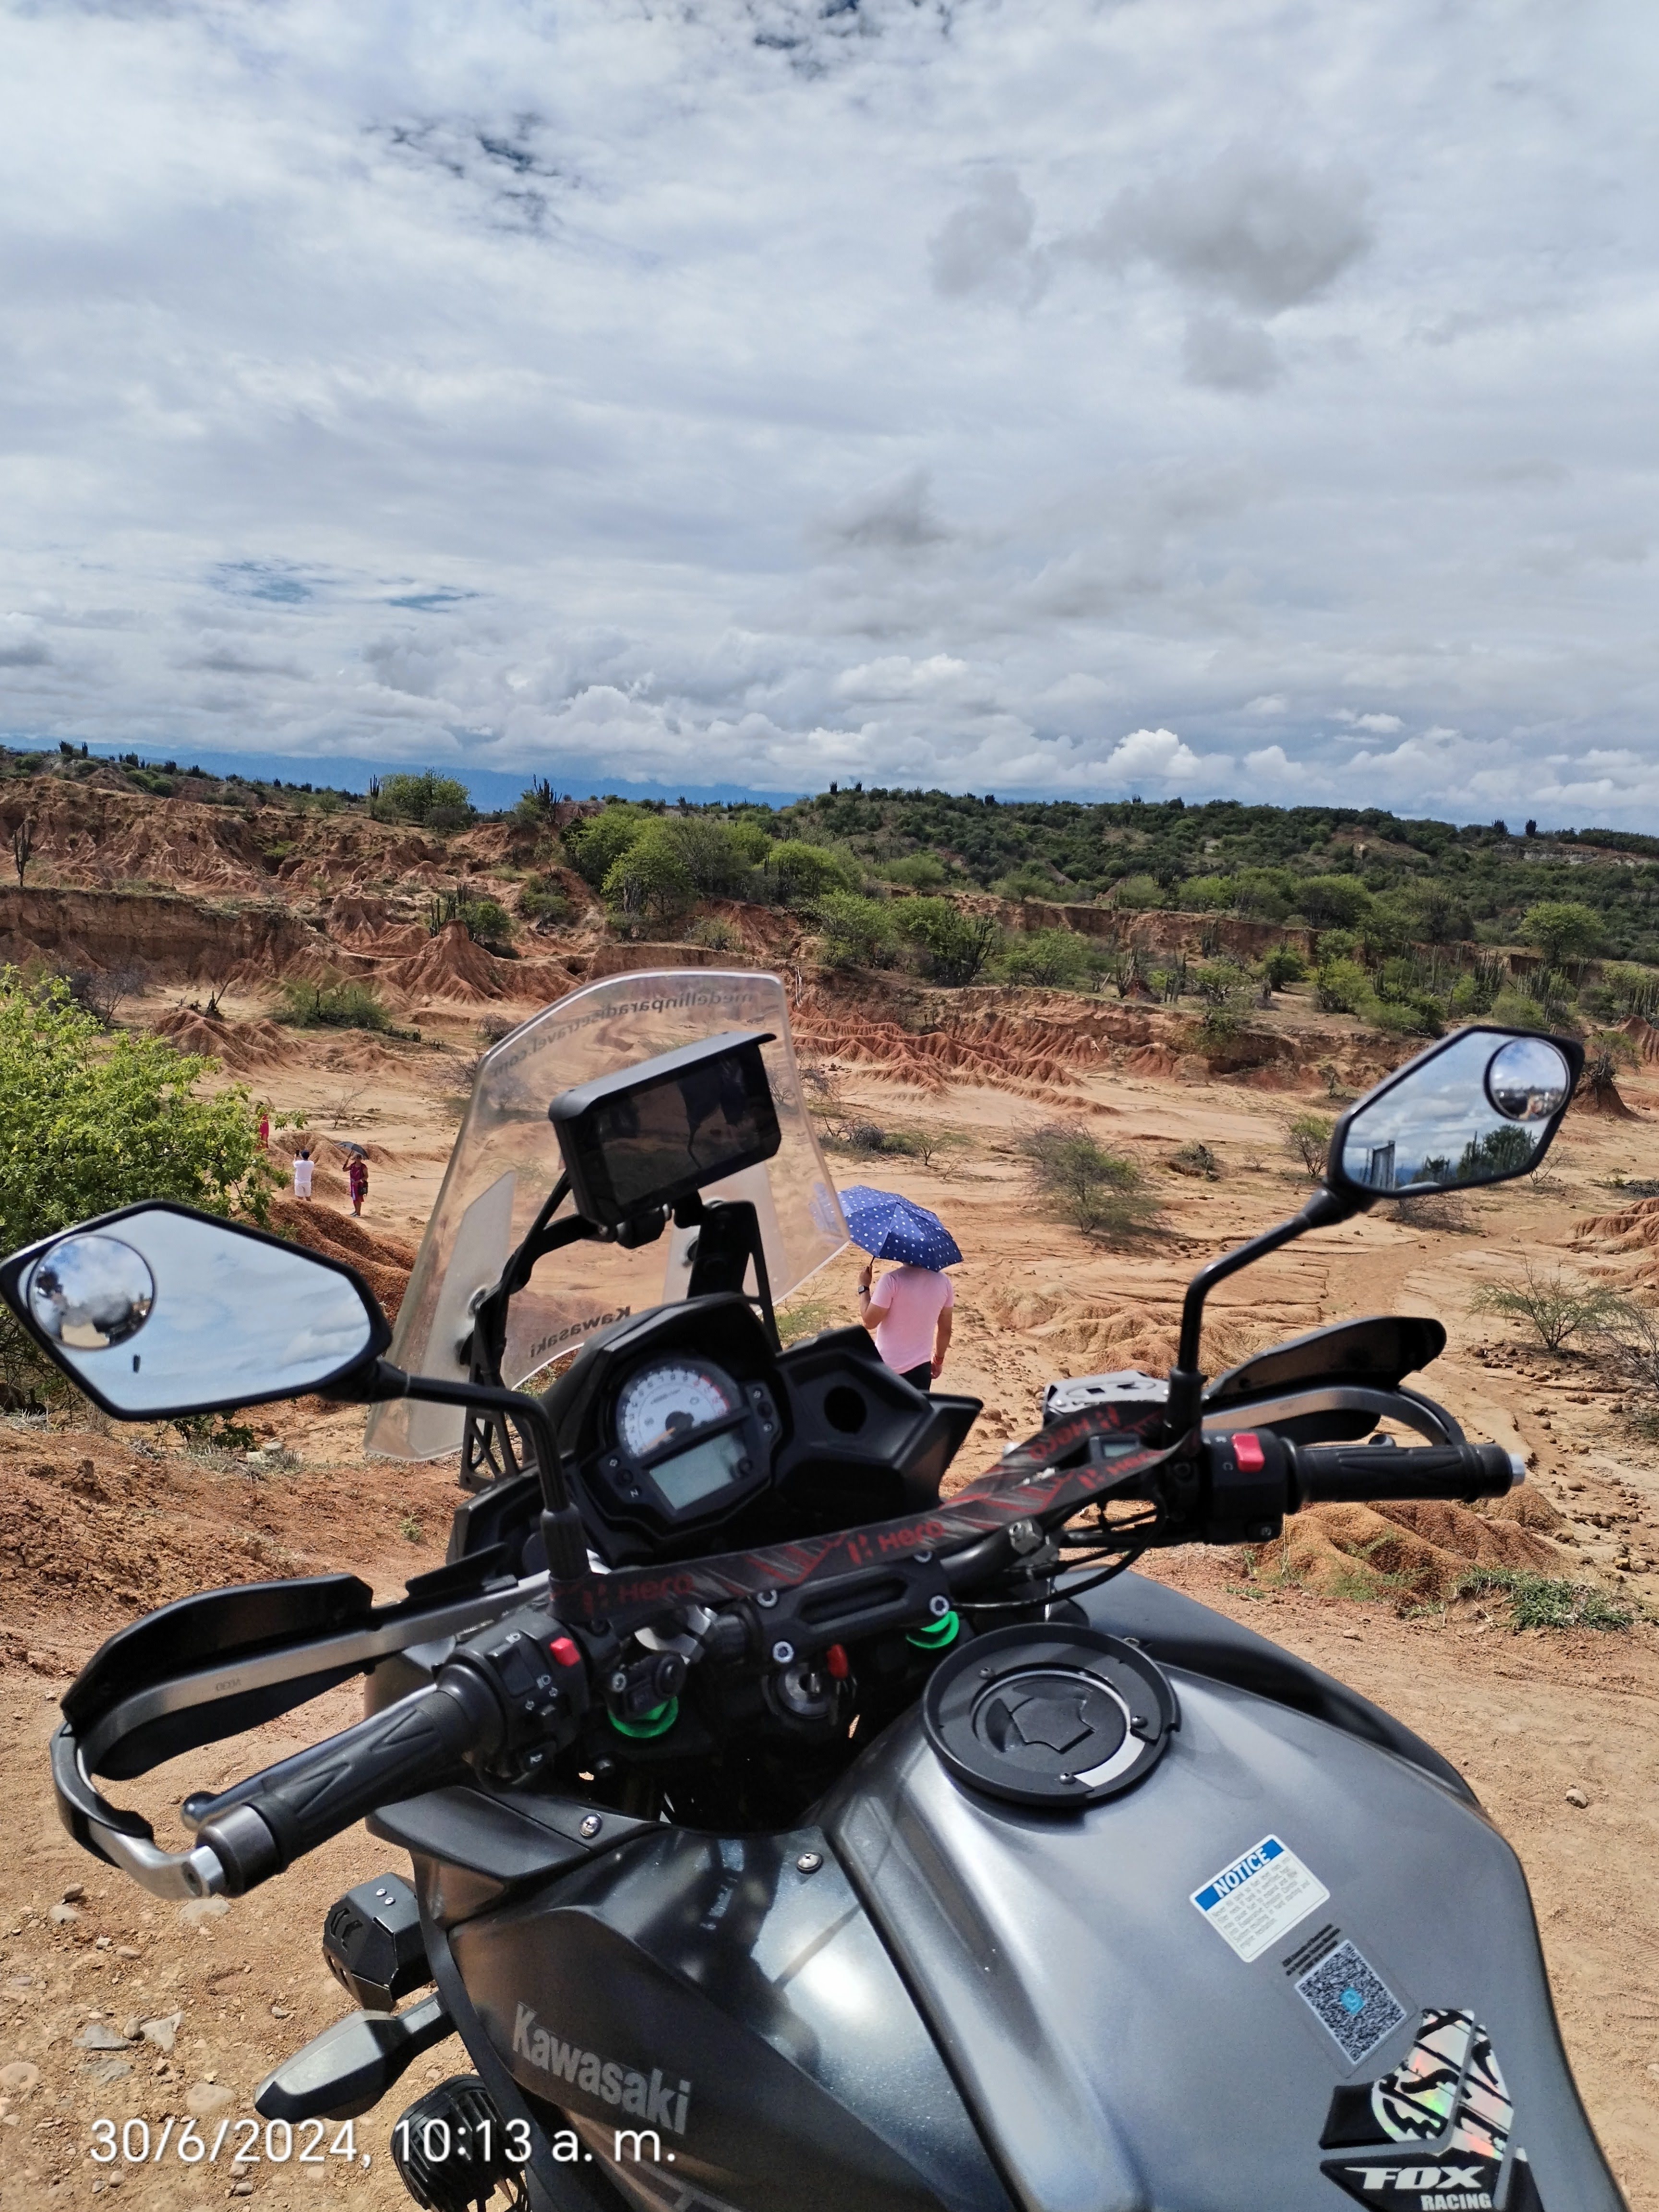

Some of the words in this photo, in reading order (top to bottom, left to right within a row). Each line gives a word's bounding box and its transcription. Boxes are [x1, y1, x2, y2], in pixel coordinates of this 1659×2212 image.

[1212, 1848, 1270, 1898] NOTICE
[512, 2001, 691, 2135] Kawasaki
[1345, 2166, 1485, 2189] FOX
[1421, 2192, 1492, 2211] RACING
